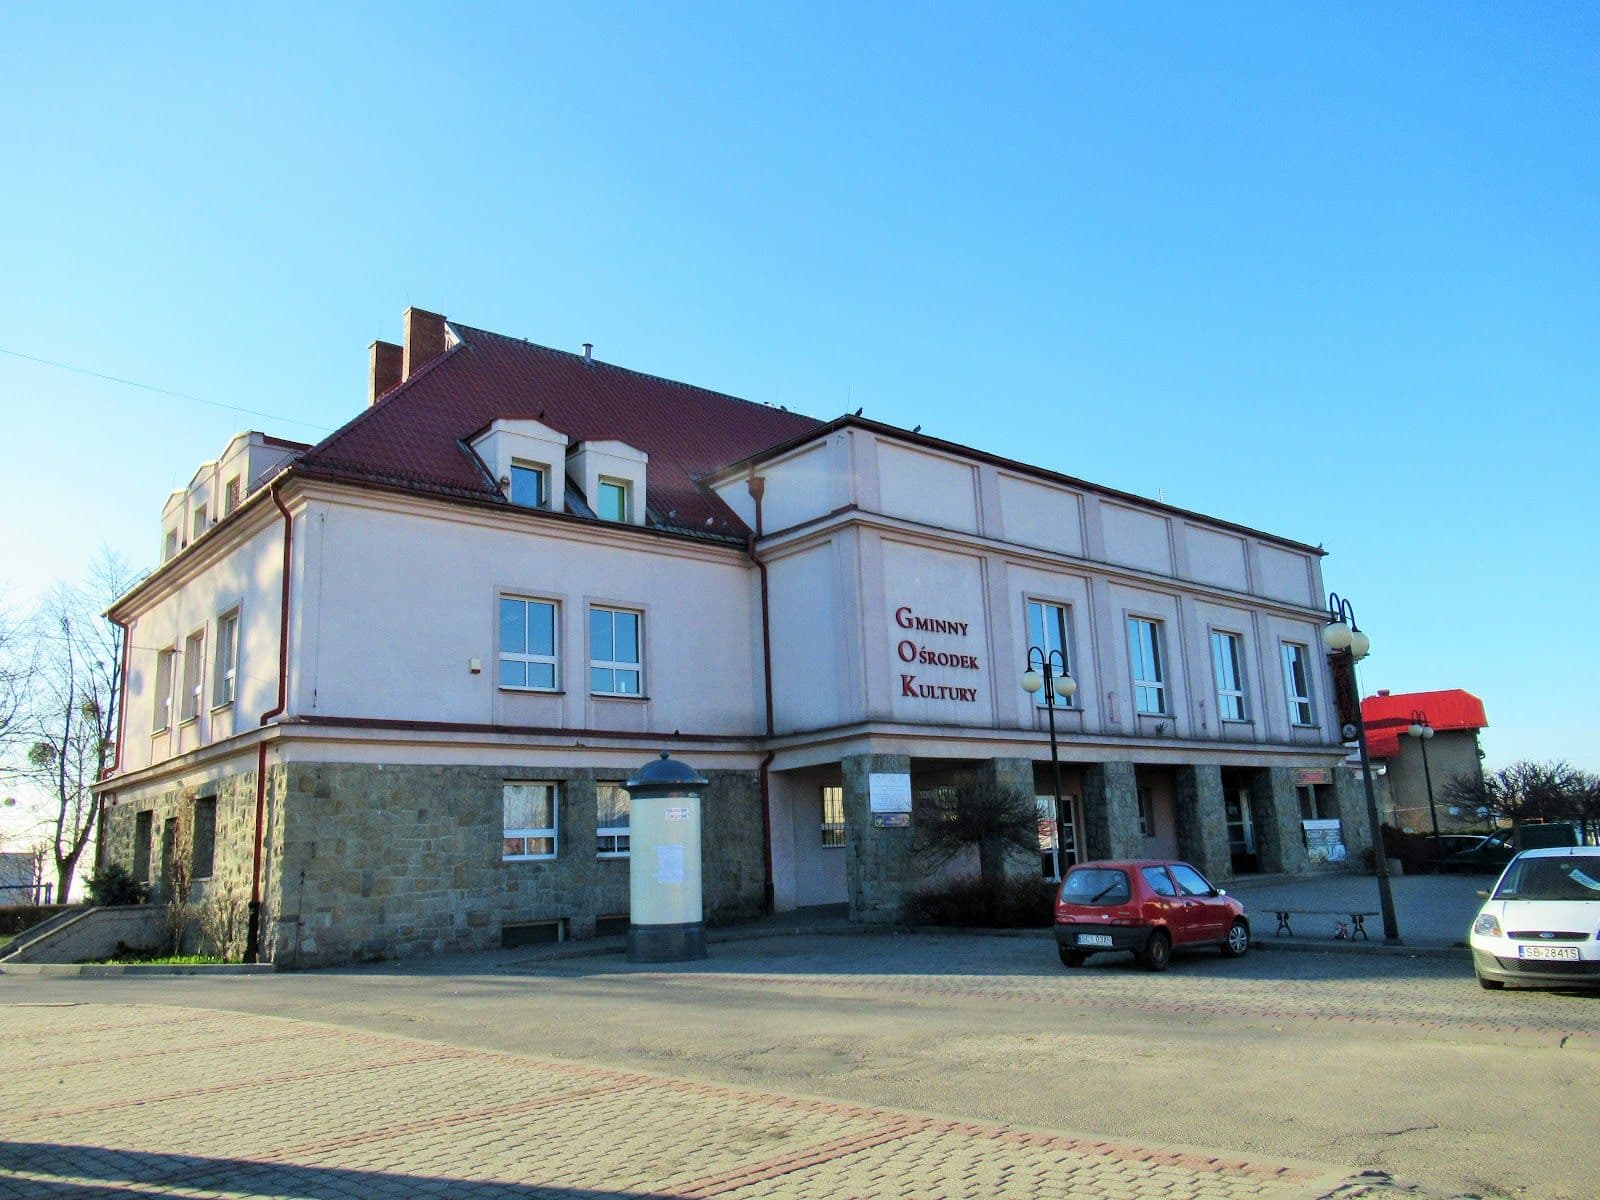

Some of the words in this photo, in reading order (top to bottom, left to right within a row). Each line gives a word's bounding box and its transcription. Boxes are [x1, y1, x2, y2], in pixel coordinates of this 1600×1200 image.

[895, 606, 969, 636] GMINNY
[897, 640, 980, 669] OŚRODEK
[900, 674, 977, 702] KULTURY
